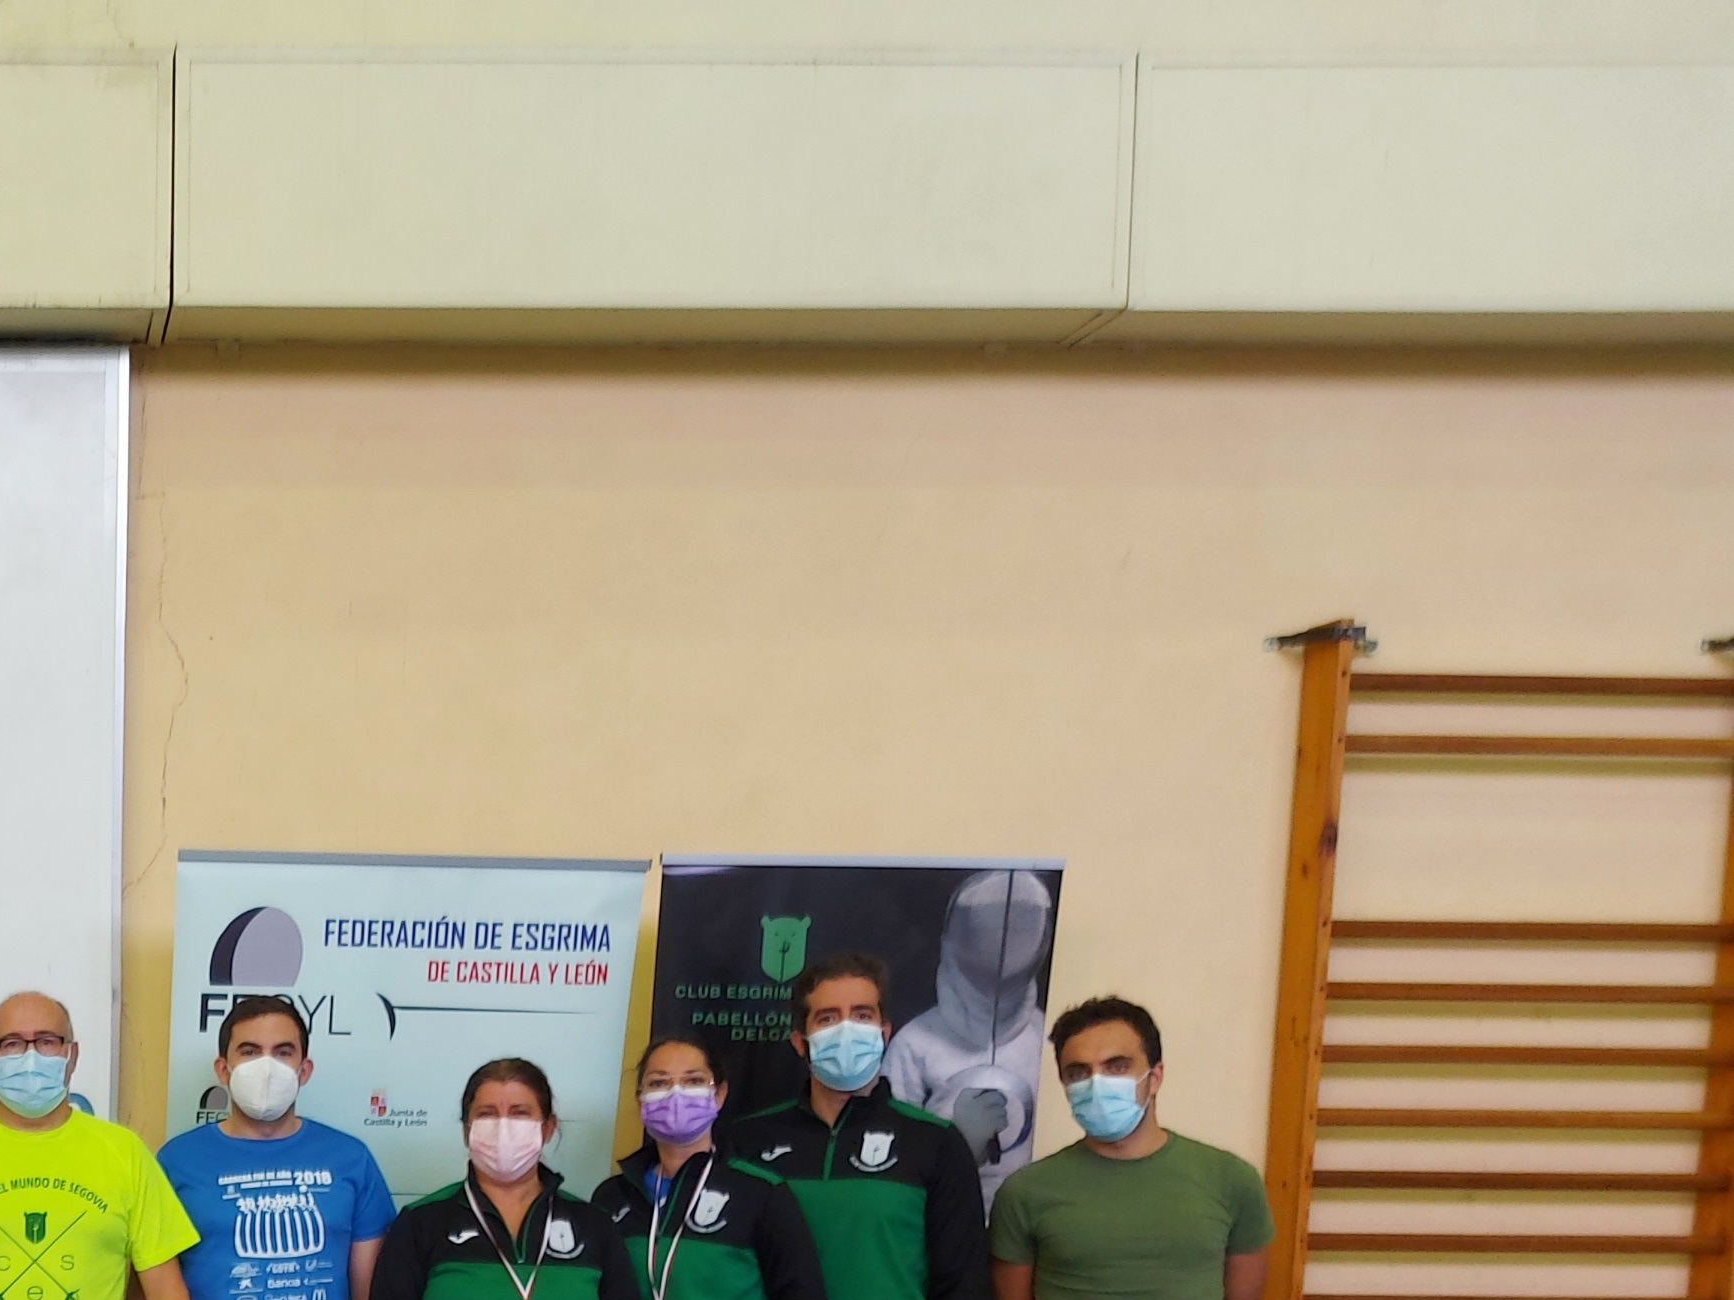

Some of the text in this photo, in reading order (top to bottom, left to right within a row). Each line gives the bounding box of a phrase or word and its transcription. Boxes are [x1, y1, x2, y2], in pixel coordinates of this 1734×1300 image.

[324, 914, 611, 954] FEDERACIÓN DE ESGRIMA
[427, 958, 609, 986] DE CASTILLA Y LEÓN
[675, 984, 793, 1000] CLUB ESGRIM
[691, 1010, 793, 1027] PABELLÓN
[293, 1170, 333, 1185] 2018
[10, 1177, 50, 1190] MUNDO
[52, 1178, 67, 1191] DE
[68, 1182, 109, 1214] SEGOVIA
